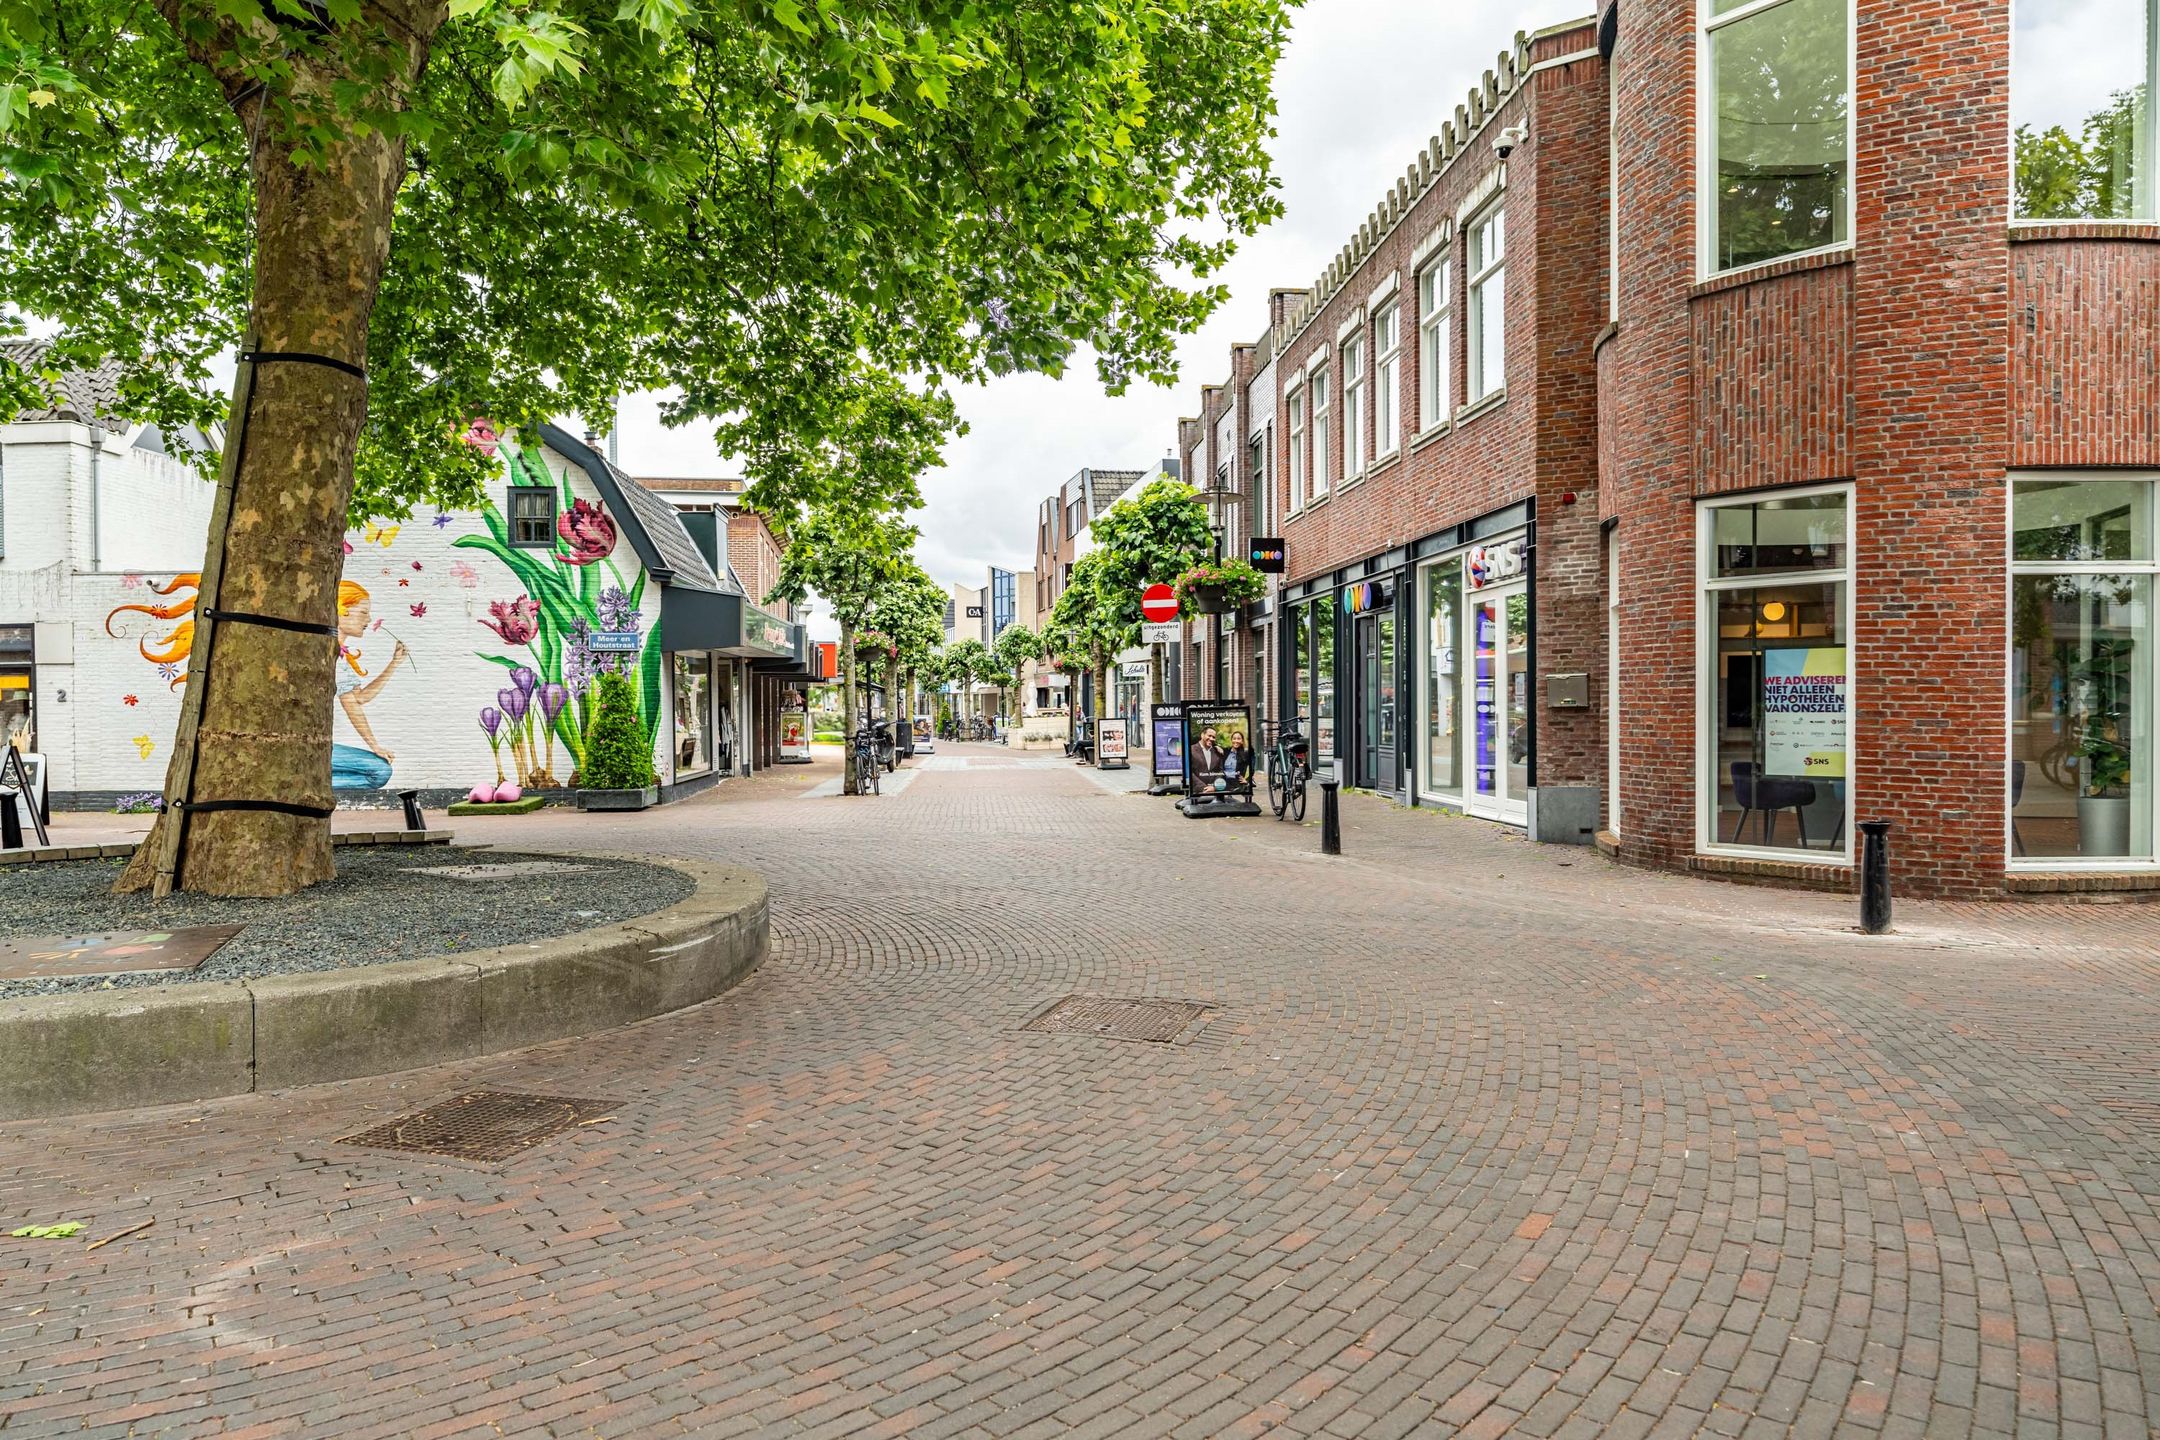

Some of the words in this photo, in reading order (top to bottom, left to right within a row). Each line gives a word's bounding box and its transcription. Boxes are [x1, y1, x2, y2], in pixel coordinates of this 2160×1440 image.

[1485, 540, 1522, 580] SNS
[1764, 676, 1782, 685] WE
[1790, 685, 1835, 695] ALLEEN
[57, 689, 67, 703] 2
[1190, 711, 1215, 719] Woning
